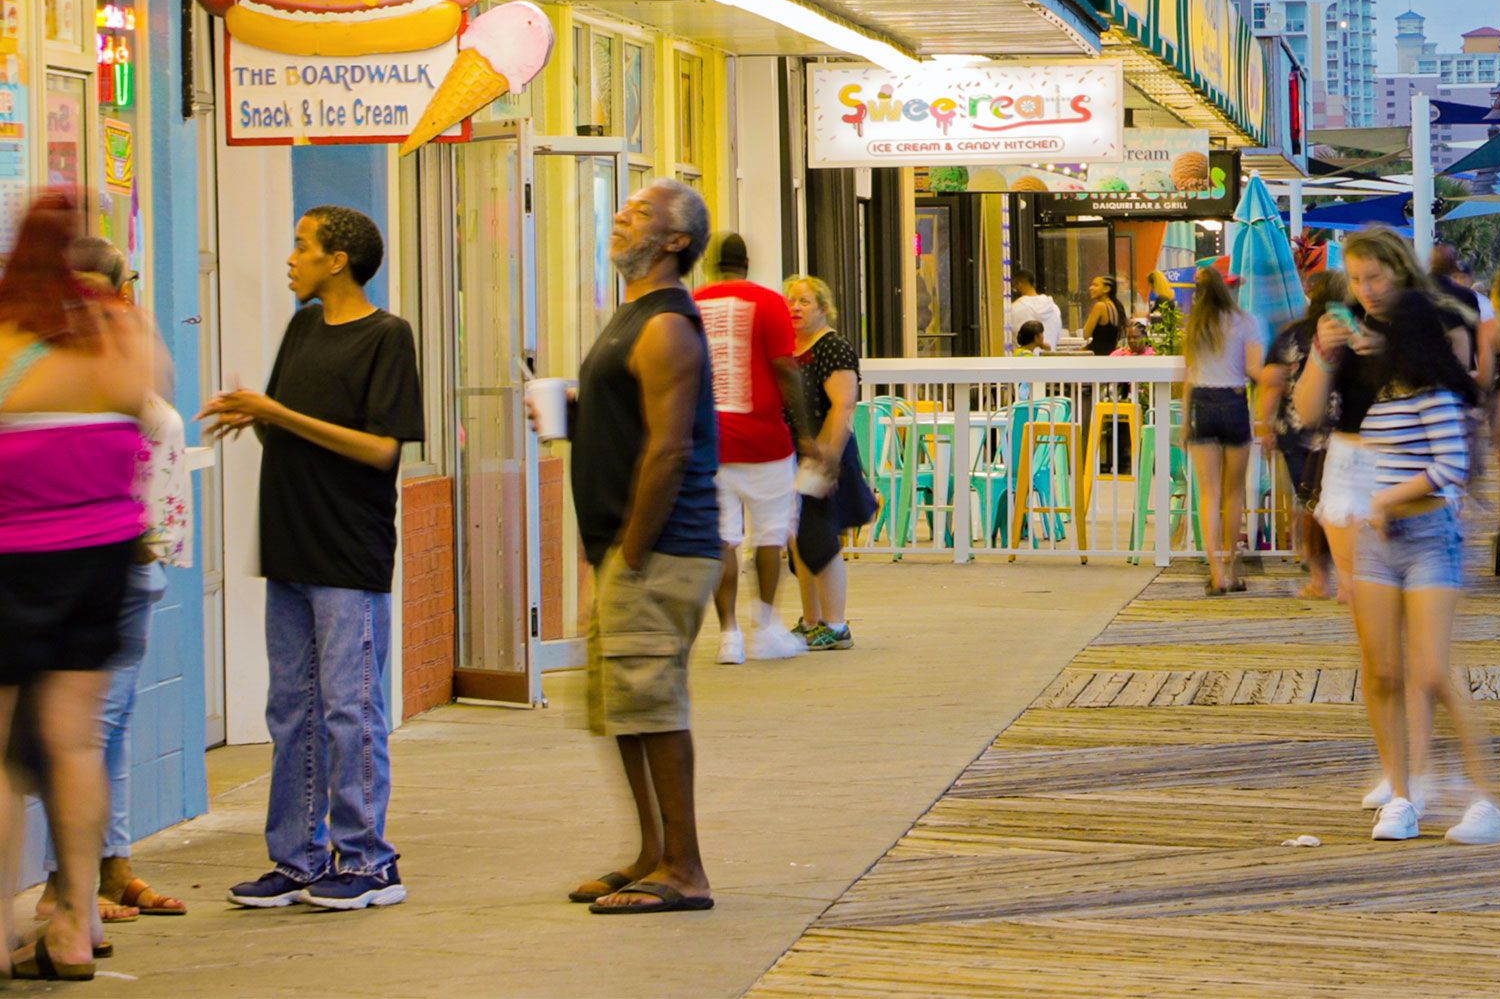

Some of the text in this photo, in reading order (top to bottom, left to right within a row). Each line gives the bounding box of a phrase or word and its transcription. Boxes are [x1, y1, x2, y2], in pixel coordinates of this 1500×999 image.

[233, 64, 435, 92] THE BOARDWALK
[240, 98, 409, 128] Snack & Ice Cream
[872, 144, 892, 153] ICE
[896, 142, 941, 152] CREAM
[945, 142, 953, 151] &
[1123, 144, 1170, 161] ream
[1092, 201, 1188, 210] DAIQUIRI BAR & GRILL
